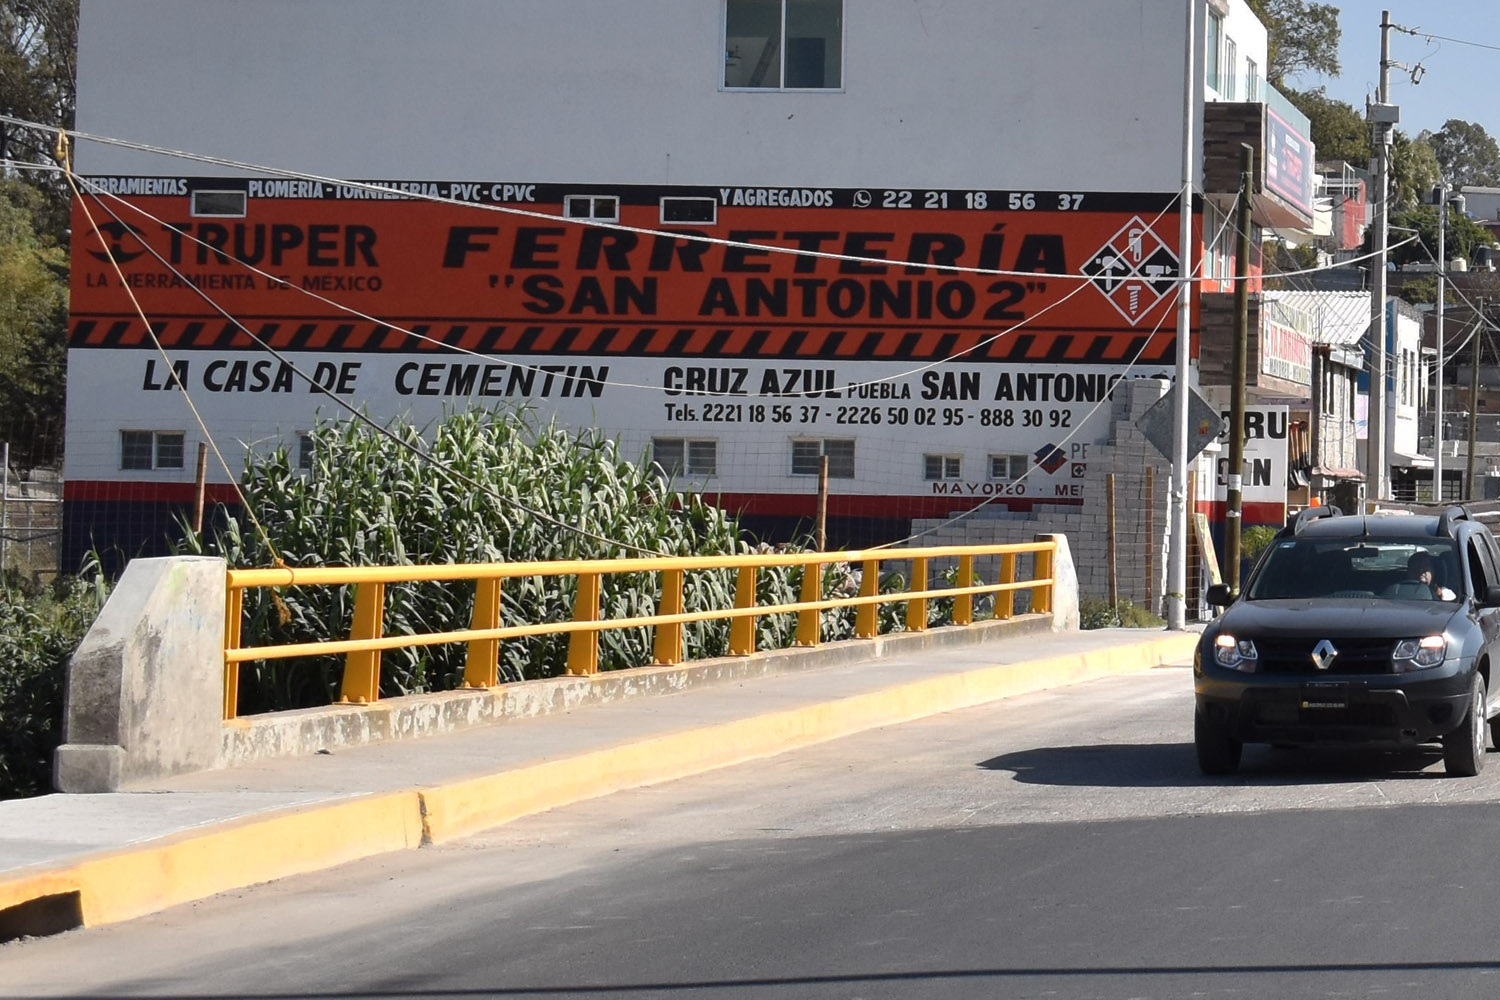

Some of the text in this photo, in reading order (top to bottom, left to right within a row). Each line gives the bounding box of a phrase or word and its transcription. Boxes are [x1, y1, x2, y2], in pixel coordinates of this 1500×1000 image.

[80, 177, 188, 196] HERRAMIENTAS
[249, 180, 323, 199] PLOMERIA
[733, 188, 833, 208] AGREGADOS
[882, 191, 1084, 210] 22 21 18 56 37
[160, 223, 379, 268] TRUPER
[443, 222, 1067, 276] FERRETERÍA
[86, 273, 108, 287] LA
[120, 273, 255, 290] HERRAMIENTA
[267, 276, 290, 290] DE
[698, 277, 976, 319] ANTONIO
[143, 359, 609, 397] LA CASA DE CEMENTIN
[664, 367, 748, 397] CRUZ
[759, 369, 842, 399] AZUL
[848, 382, 911, 399] PUEBLA
[921, 371, 981, 400] SAN
[664, 403, 699, 422] Tels.
[702, 404, 742, 422] 2221
[750, 405, 765, 423] 18
[772, 405, 792, 423] 56
[799, 406, 820, 423] 37
[836, 406, 882, 424] 2226
[887, 407, 909, 425] 50
[914, 408, 936, 426] 02
[943, 408, 964, 426] 95
[980, 409, 1014, 427] 888
[1022, 410, 1043, 427] 30
[1049, 410, 1071, 428] 92
[932, 482, 1026, 496] MAYOREO
